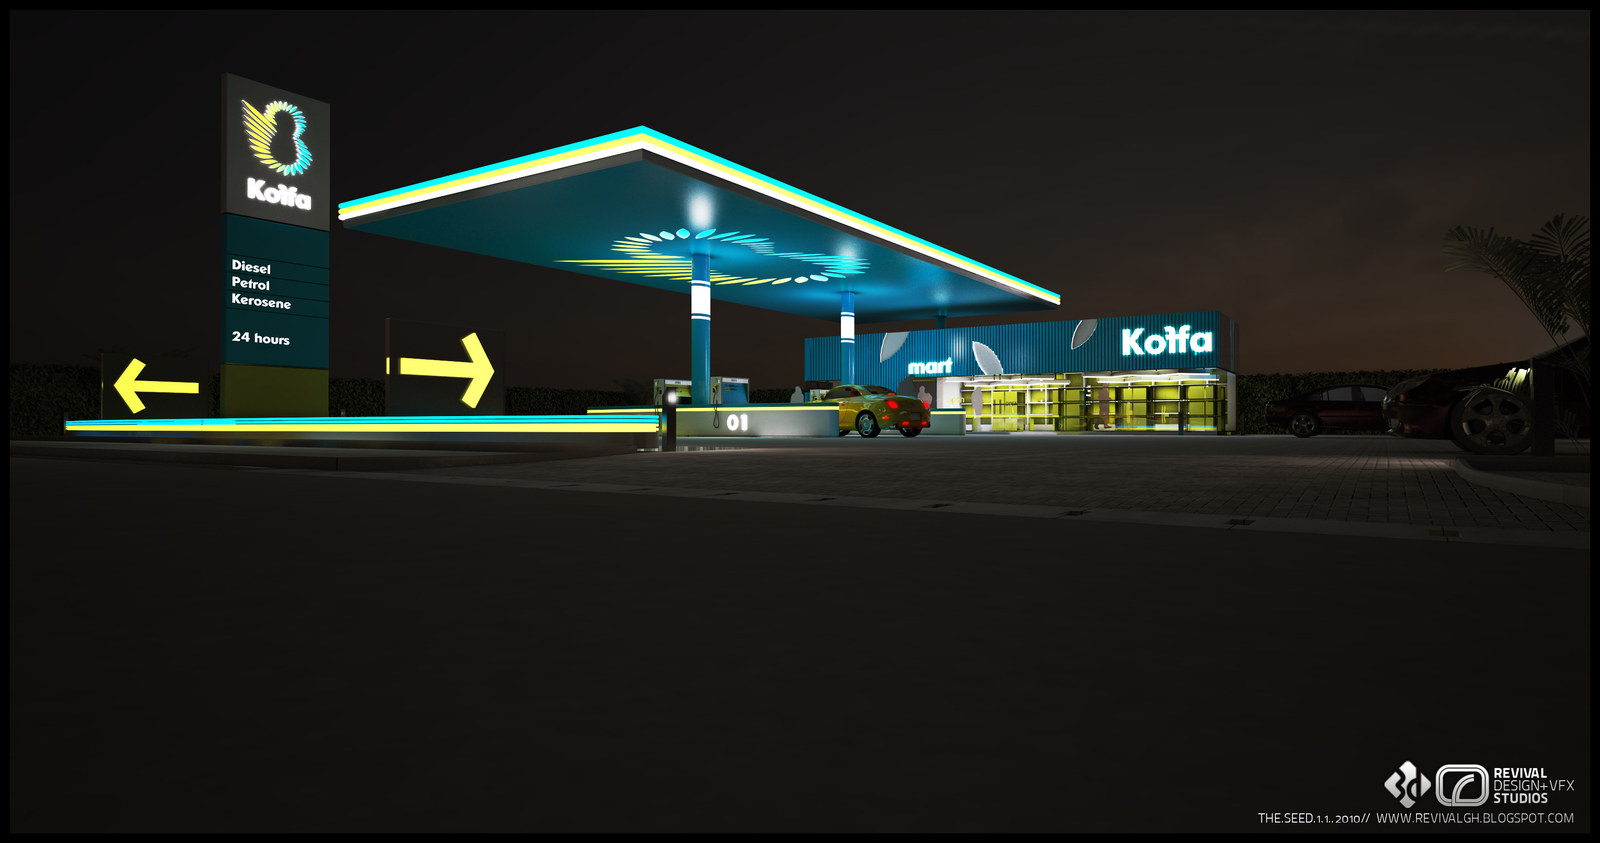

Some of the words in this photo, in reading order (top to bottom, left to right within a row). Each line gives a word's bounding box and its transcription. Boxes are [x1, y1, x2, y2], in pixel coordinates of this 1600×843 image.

[231, 258, 271, 275] Diesel
[231, 275, 270, 291] Petrol
[231, 292, 292, 310] Kerosene
[231, 331, 251, 343] 24
[254, 332, 291, 346] hours
[908, 357, 953, 375] mart
[726, 413, 749, 432] 01
